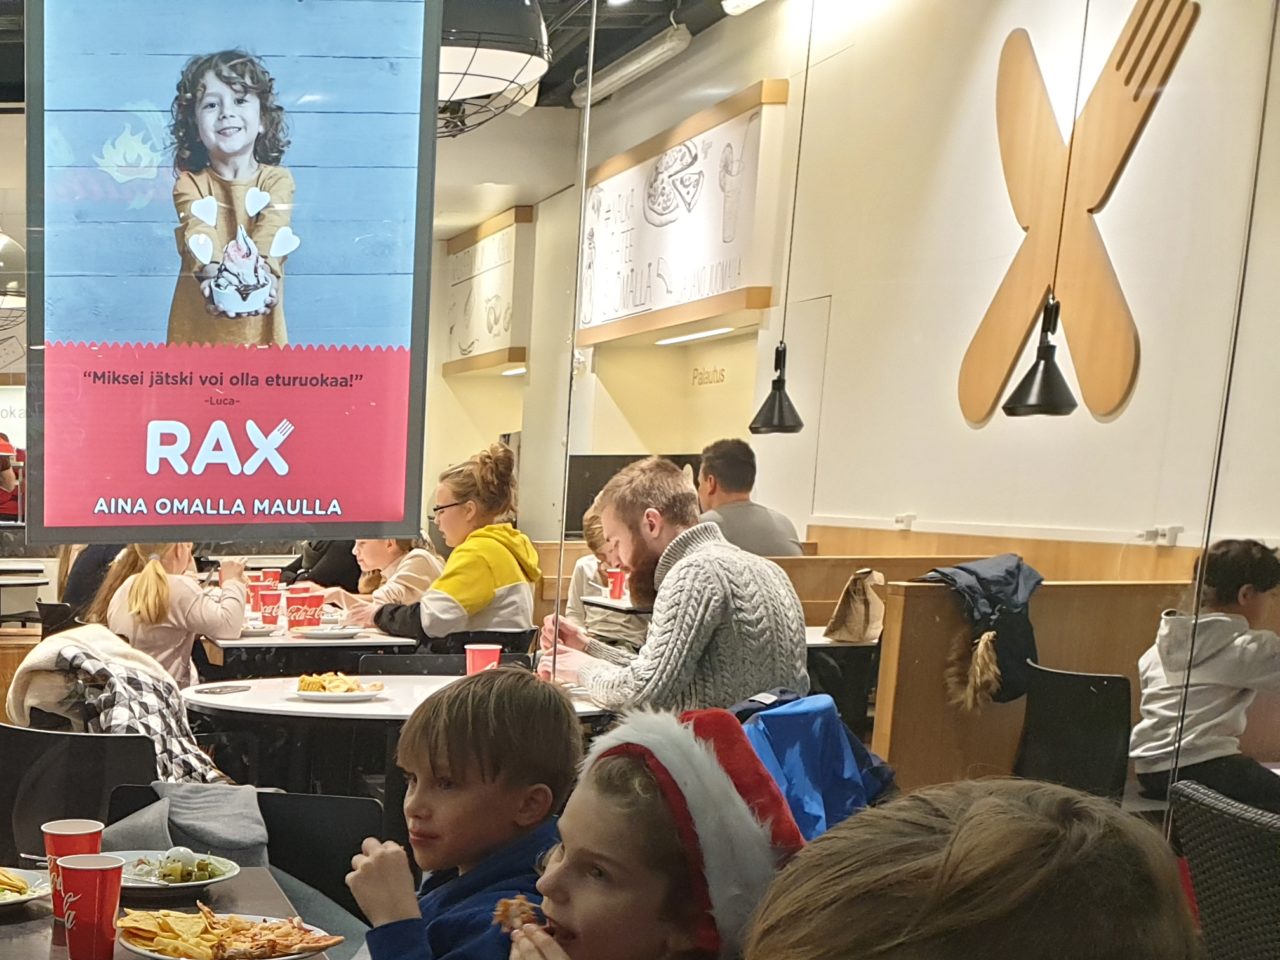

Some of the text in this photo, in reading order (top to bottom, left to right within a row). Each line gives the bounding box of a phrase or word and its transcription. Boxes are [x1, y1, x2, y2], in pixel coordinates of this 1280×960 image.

[83, 371, 364, 388] “Miksei jätski voi olla eturuokaa!”
[145, 418, 295, 475] RAX
[93, 497, 342, 515] AINA OMALLA MAULLA
